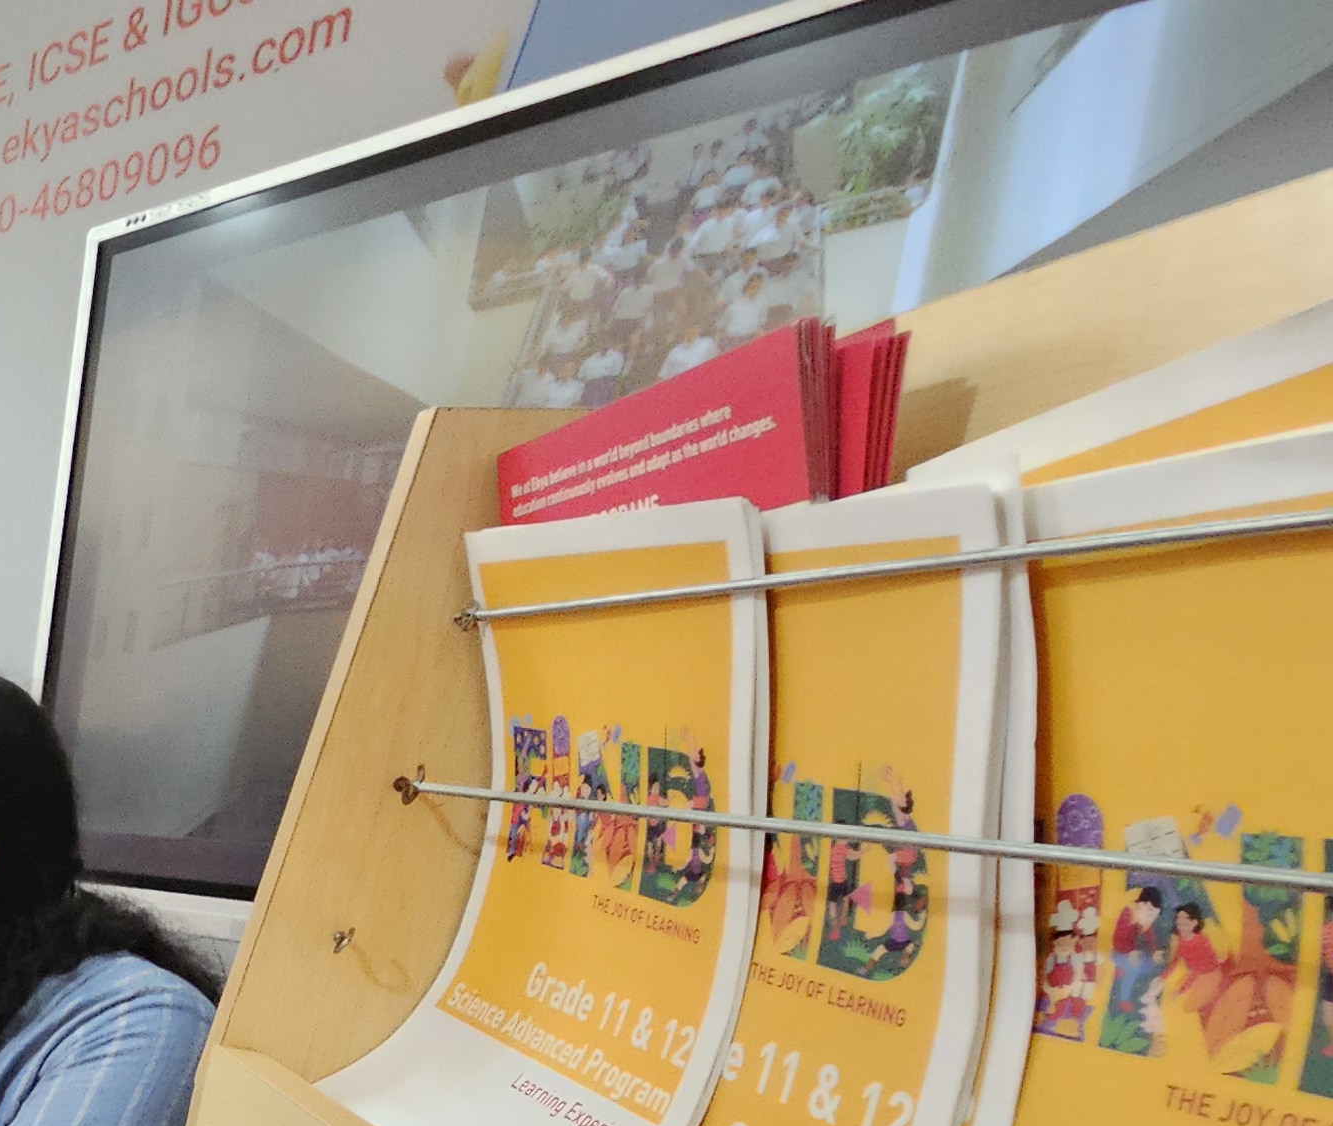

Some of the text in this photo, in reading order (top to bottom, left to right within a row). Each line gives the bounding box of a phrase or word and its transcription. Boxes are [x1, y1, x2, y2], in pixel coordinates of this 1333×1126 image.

[28, 19, 110, 92] ICSE
[123, 7, 148, 51] &
[646, 450, 671, 473] adapt
[683, 441, 699, 460] the
[699, 428, 728, 454] world
[728, 415, 778, 443] changes.
[650, 417, 700, 448] boundaries
[700, 405, 732, 429] where
[591, 895, 610, 913] THE
[631, 907, 645, 923] OF
[645, 911, 702, 945] LEARNING
[525, 961, 594, 1023] Grade
[598, 991, 631, 1037] 11
[631, 1008, 655, 1052] &
[660, 1020, 698, 1071] 12
[750, 962, 908, 1029] THE JOY OF LEARNING
[446, 981, 504, 1032] Science
[501, 1012, 583, 1073] Advanced
[583, 1046, 673, 1117] Program
[510, 1071, 567, 1118] Learning
[807, 1063, 843, 1125] &
[1165, 1084, 1217, 1119] THE
